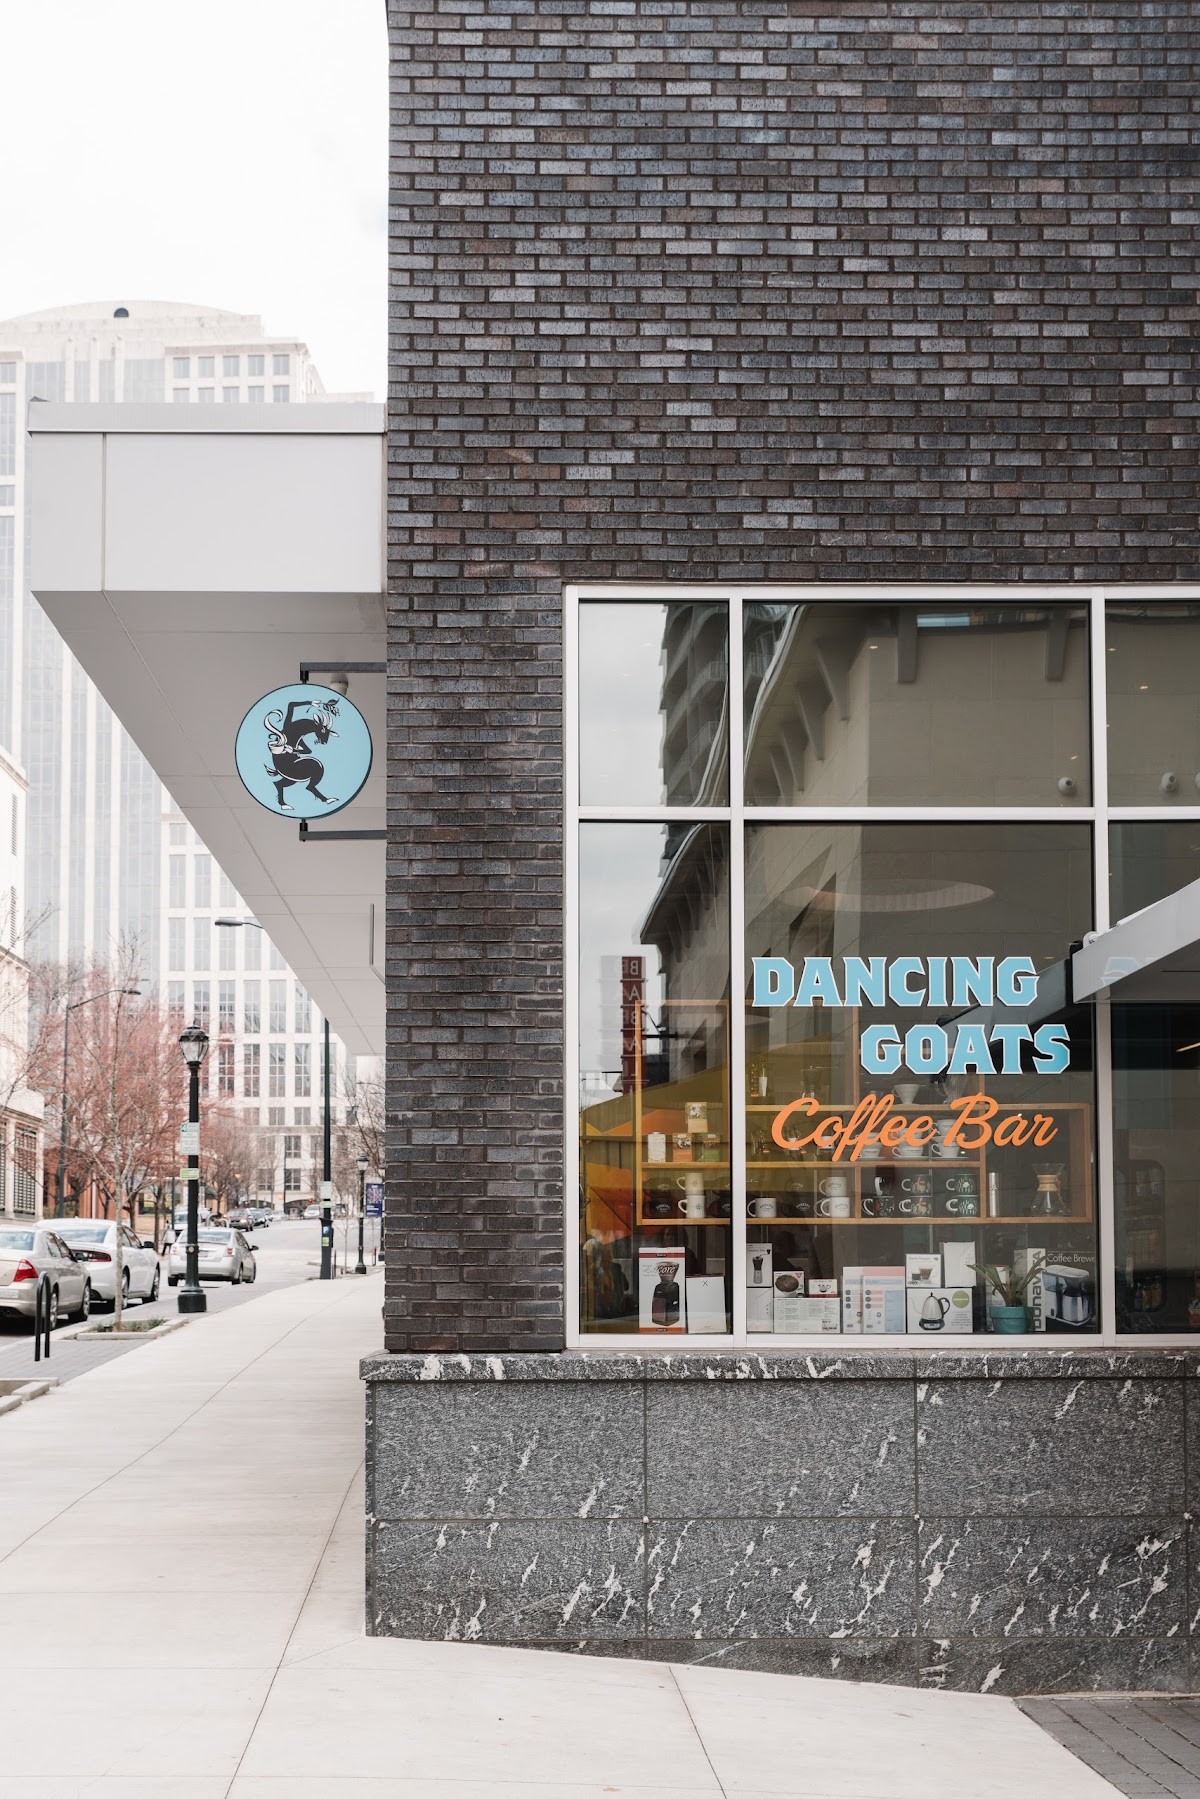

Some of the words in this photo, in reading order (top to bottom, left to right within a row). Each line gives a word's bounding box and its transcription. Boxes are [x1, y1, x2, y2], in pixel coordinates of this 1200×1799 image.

[752, 956, 1039, 1007] DANCING
[860, 1024, 1071, 1075] GOATS
[772, 1093, 937, 1162] Coffee
[944, 1091, 1058, 1149] Bar
[1046, 1253, 1073, 1263] Coffee
